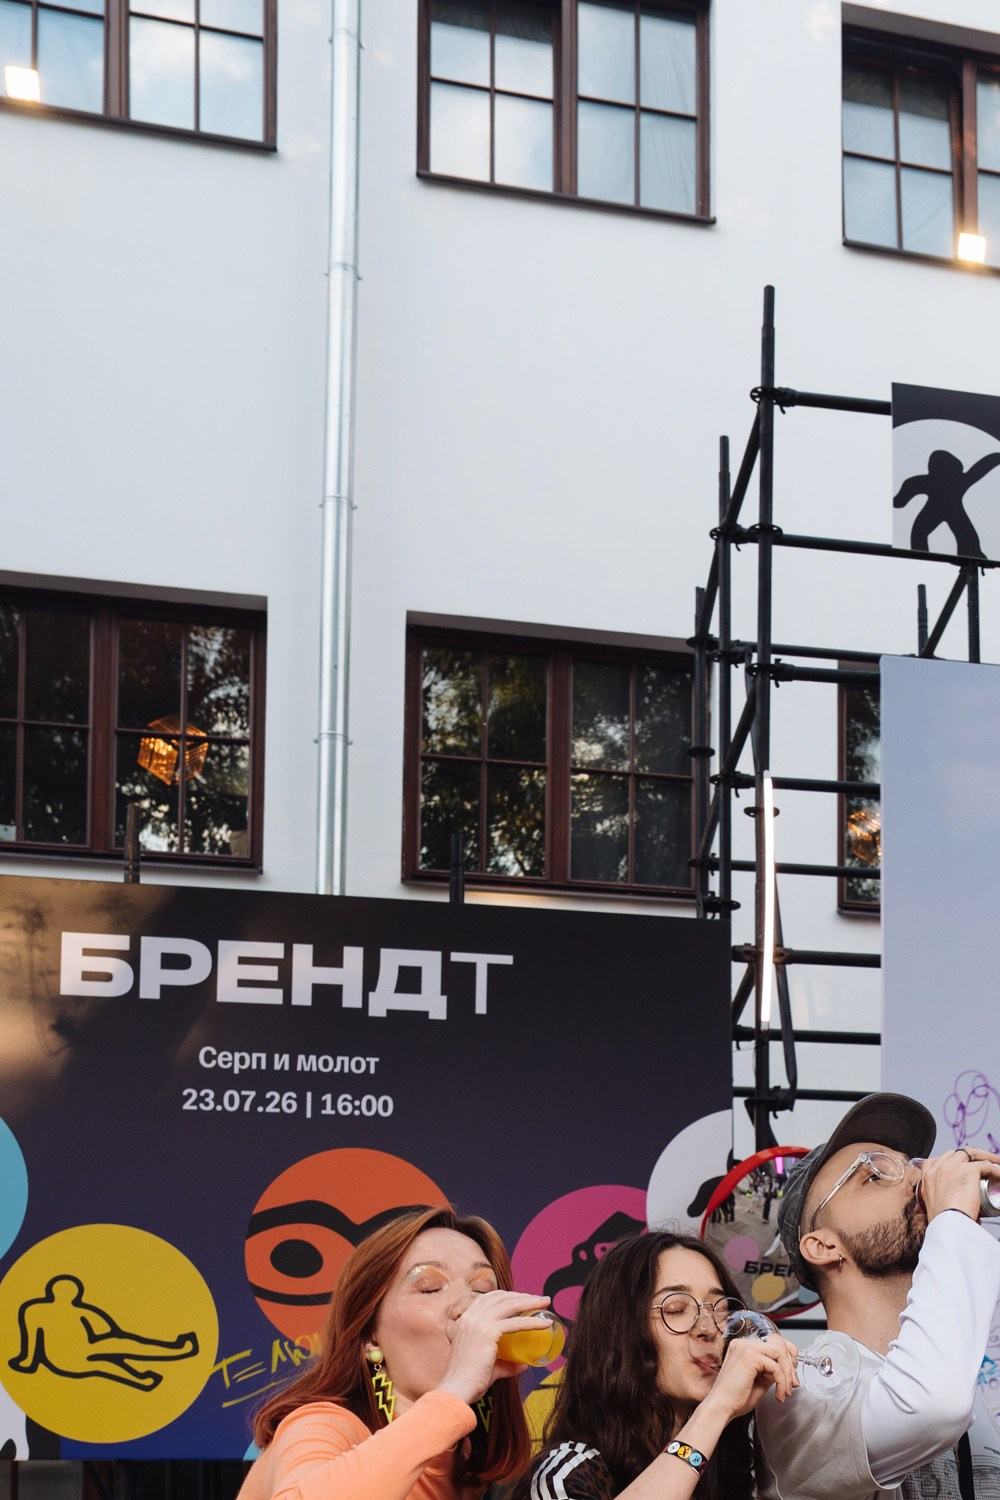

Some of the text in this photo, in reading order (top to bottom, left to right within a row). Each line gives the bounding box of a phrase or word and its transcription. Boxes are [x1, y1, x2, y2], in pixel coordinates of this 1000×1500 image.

[60, 932, 513, 1019] БРЕНДТ
[198, 1046, 379, 1074] Серп и молот
[182, 1088, 297, 1113] 23.07.26
[321, 1093, 393, 1117] 16:00
